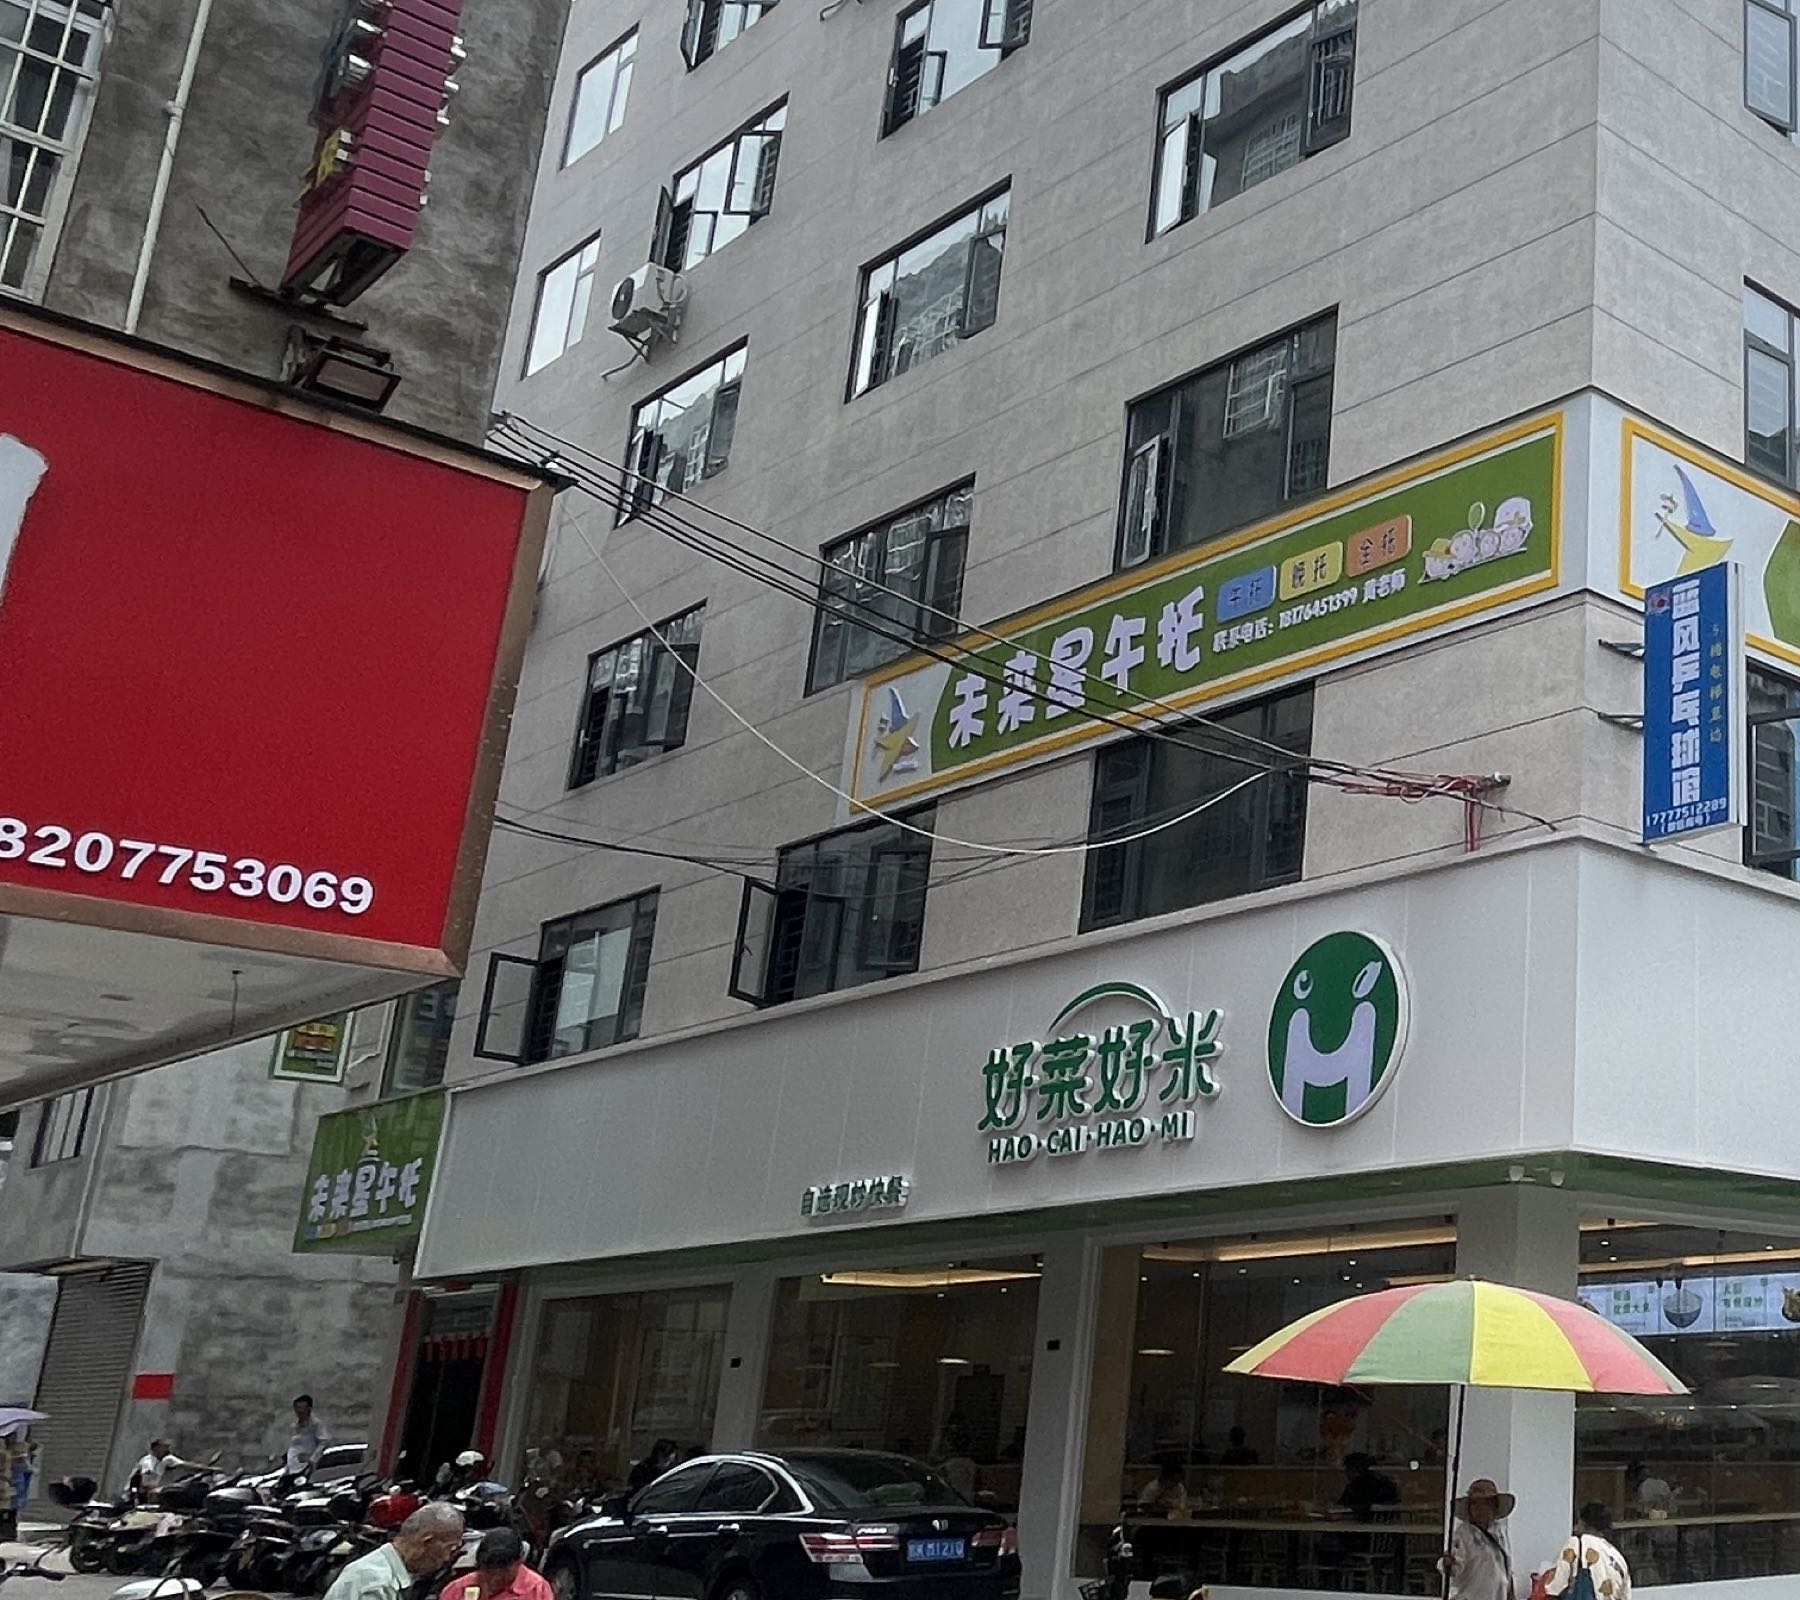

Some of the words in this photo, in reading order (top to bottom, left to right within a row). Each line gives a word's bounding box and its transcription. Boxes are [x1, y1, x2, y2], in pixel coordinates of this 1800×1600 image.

[949, 586, 1205, 749] 未来星午托
[0, 817, 374, 915] 8207753069
[977, 1009, 1223, 1130] 好菜好米
[308, 1157, 423, 1222] 未来星午托
